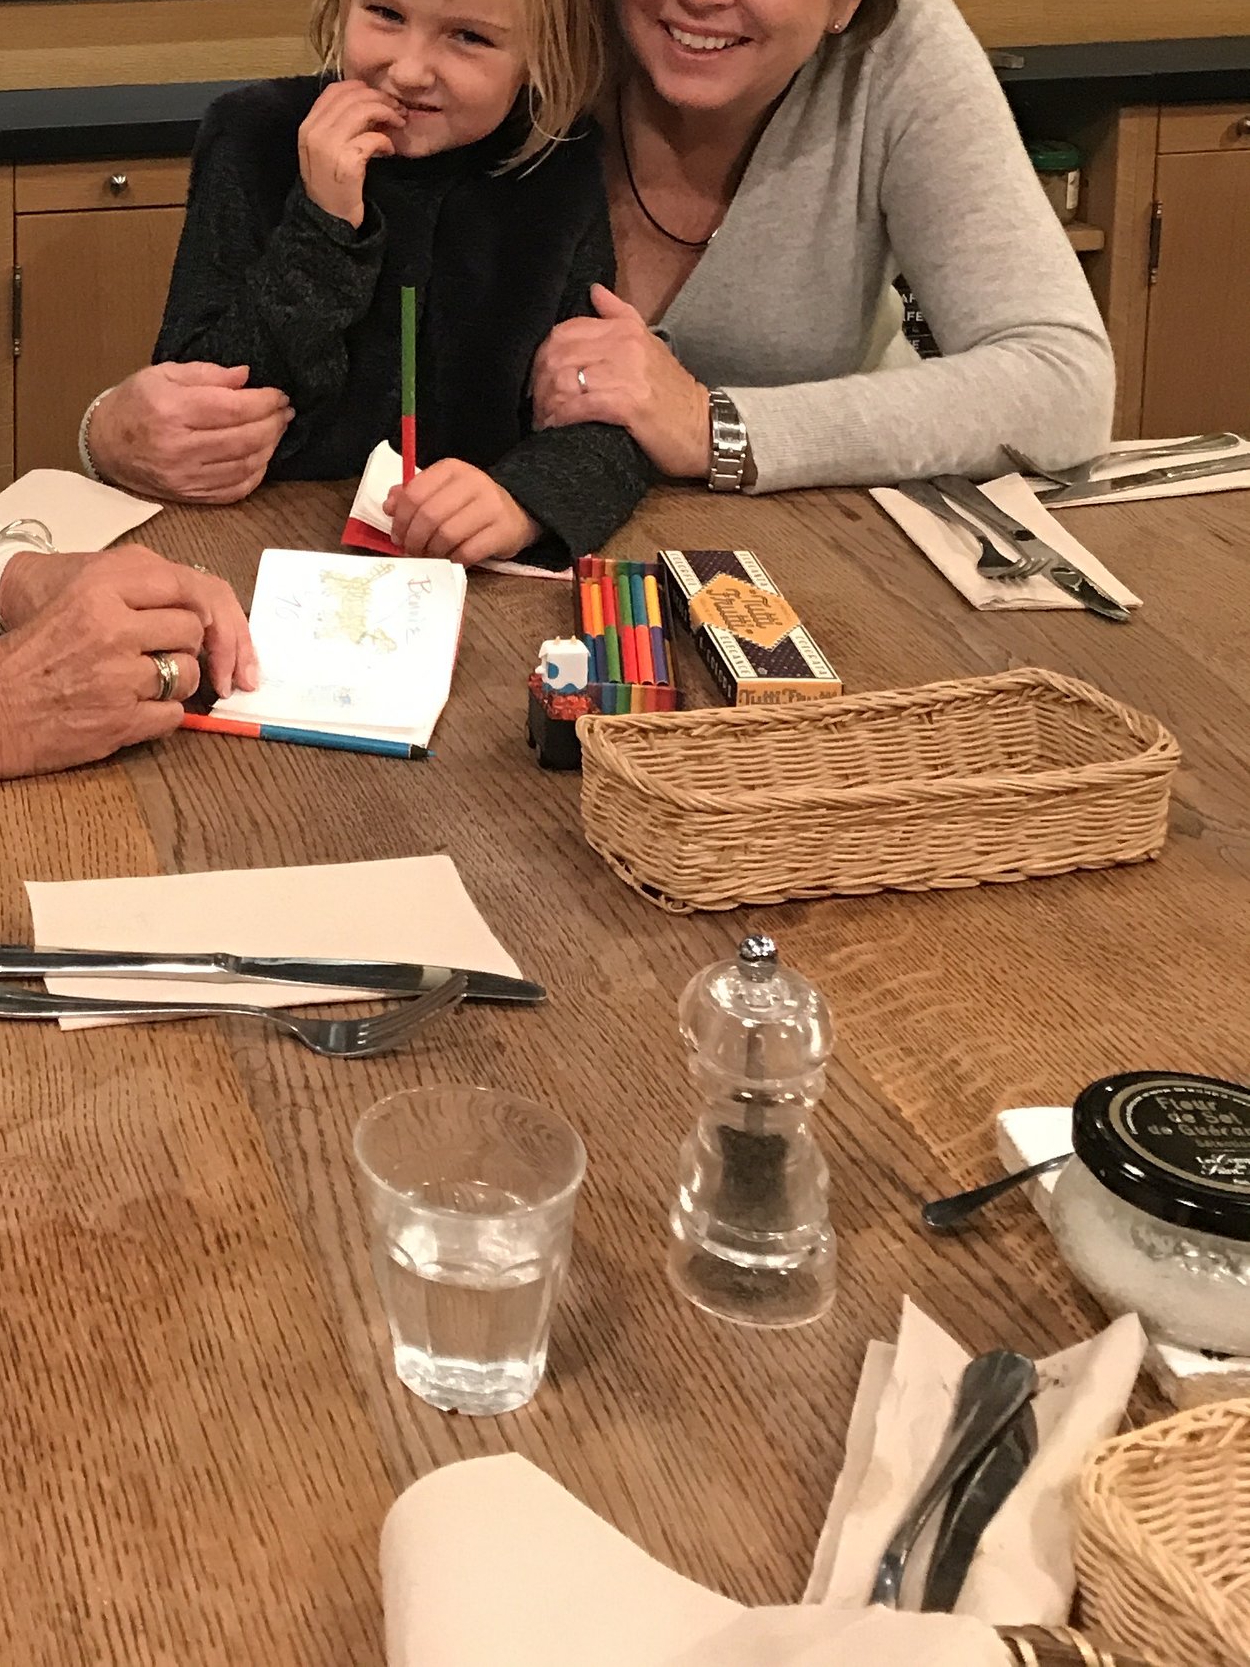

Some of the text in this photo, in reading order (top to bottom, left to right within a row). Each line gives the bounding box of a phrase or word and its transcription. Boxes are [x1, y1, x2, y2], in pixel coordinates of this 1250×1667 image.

[706, 588, 750, 633] Frutti
[741, 593, 778, 629] Tutti
[718, 635, 750, 674] ELEGANCE
[1156, 1096, 1217, 1111] Fleur
[1148, 1125, 1173, 1135] de
[1168, 1111, 1242, 1124] de Sel
